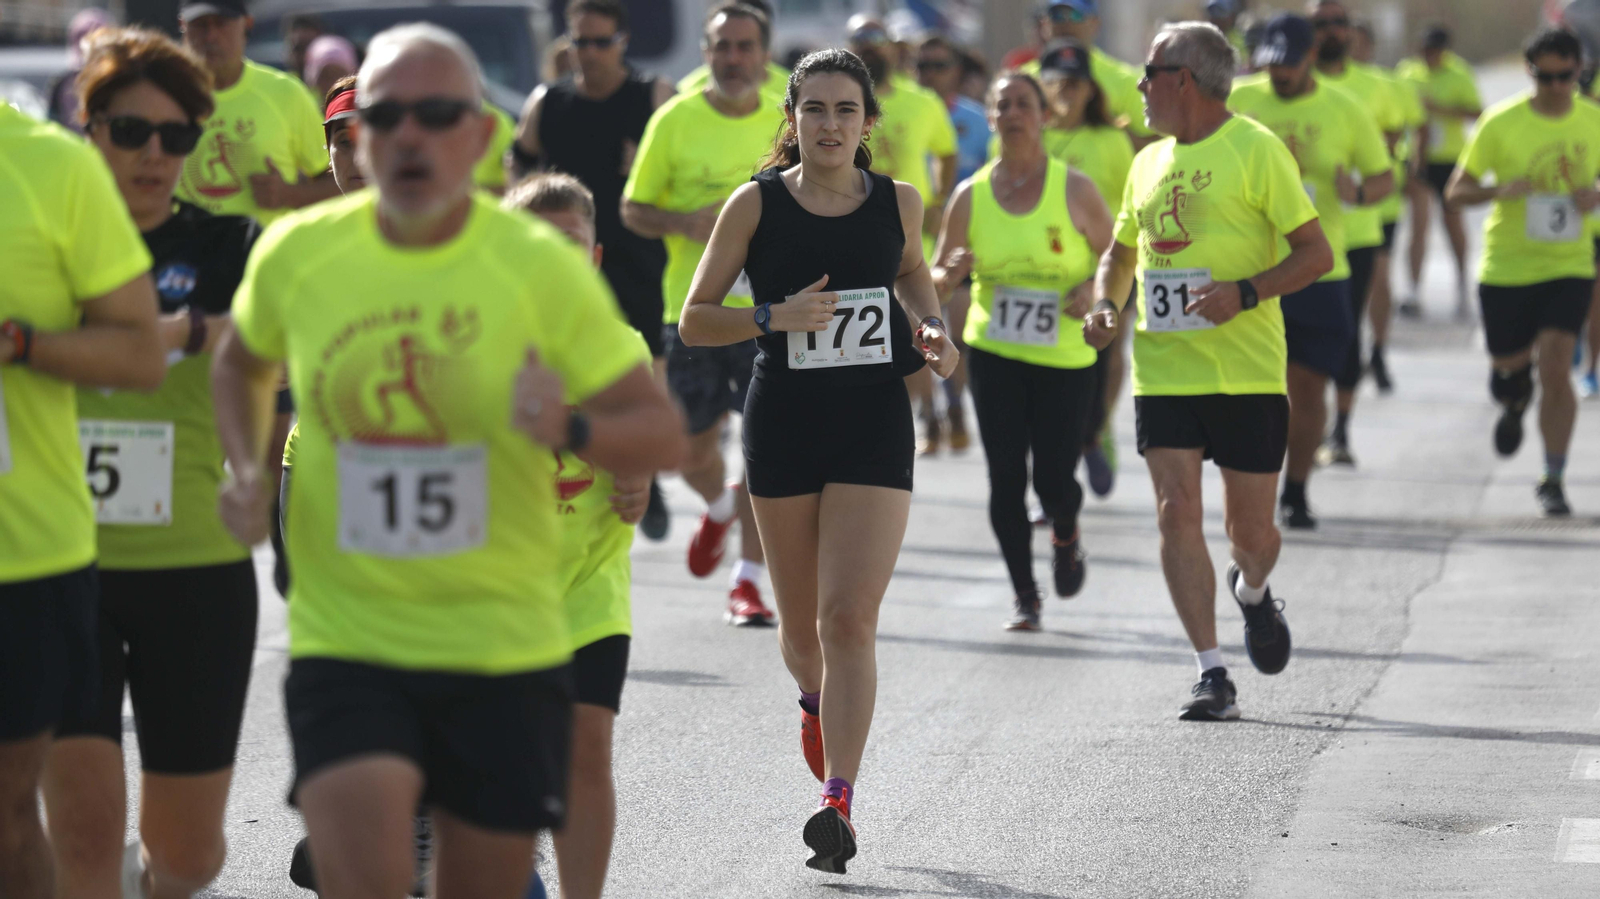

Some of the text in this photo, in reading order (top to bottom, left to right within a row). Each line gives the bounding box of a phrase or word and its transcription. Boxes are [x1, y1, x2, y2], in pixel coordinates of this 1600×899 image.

[838, 291, 886, 302] LIDARIA APRON
[997, 299, 1056, 334] 175
[86, 444, 121, 500] 5
[371, 471, 457, 534] 15
